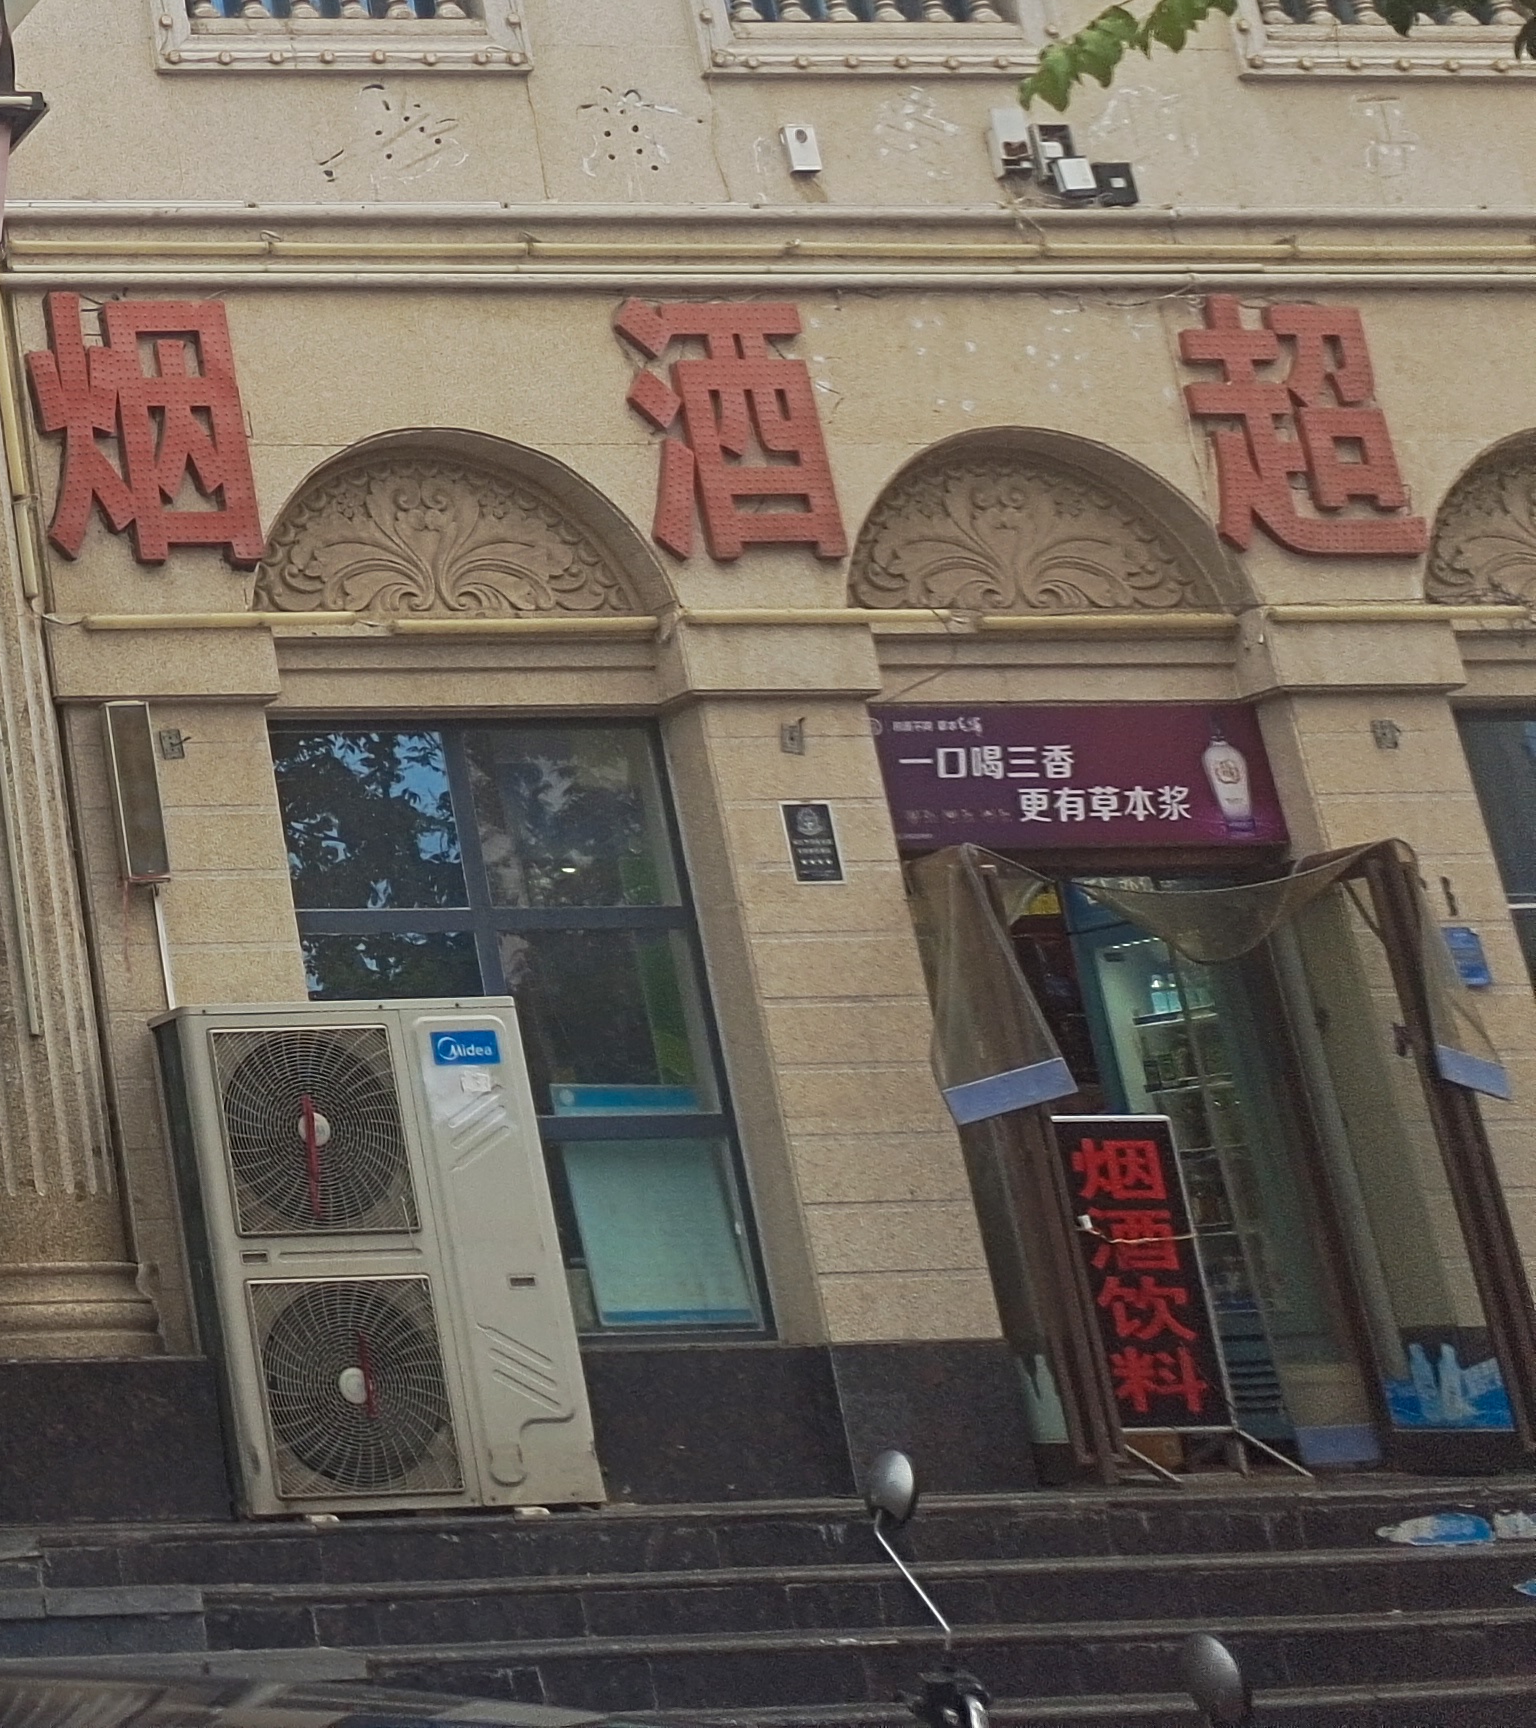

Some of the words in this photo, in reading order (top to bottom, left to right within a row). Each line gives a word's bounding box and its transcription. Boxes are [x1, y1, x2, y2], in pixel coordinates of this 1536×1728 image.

[25, 290, 1427, 566] 烟酒超
[898, 743, 1076, 781] 一口喝三香
[1017, 785, 1192, 823] 更有草本浆
[1071, 1138, 1210, 1414] 烟酒饮料
